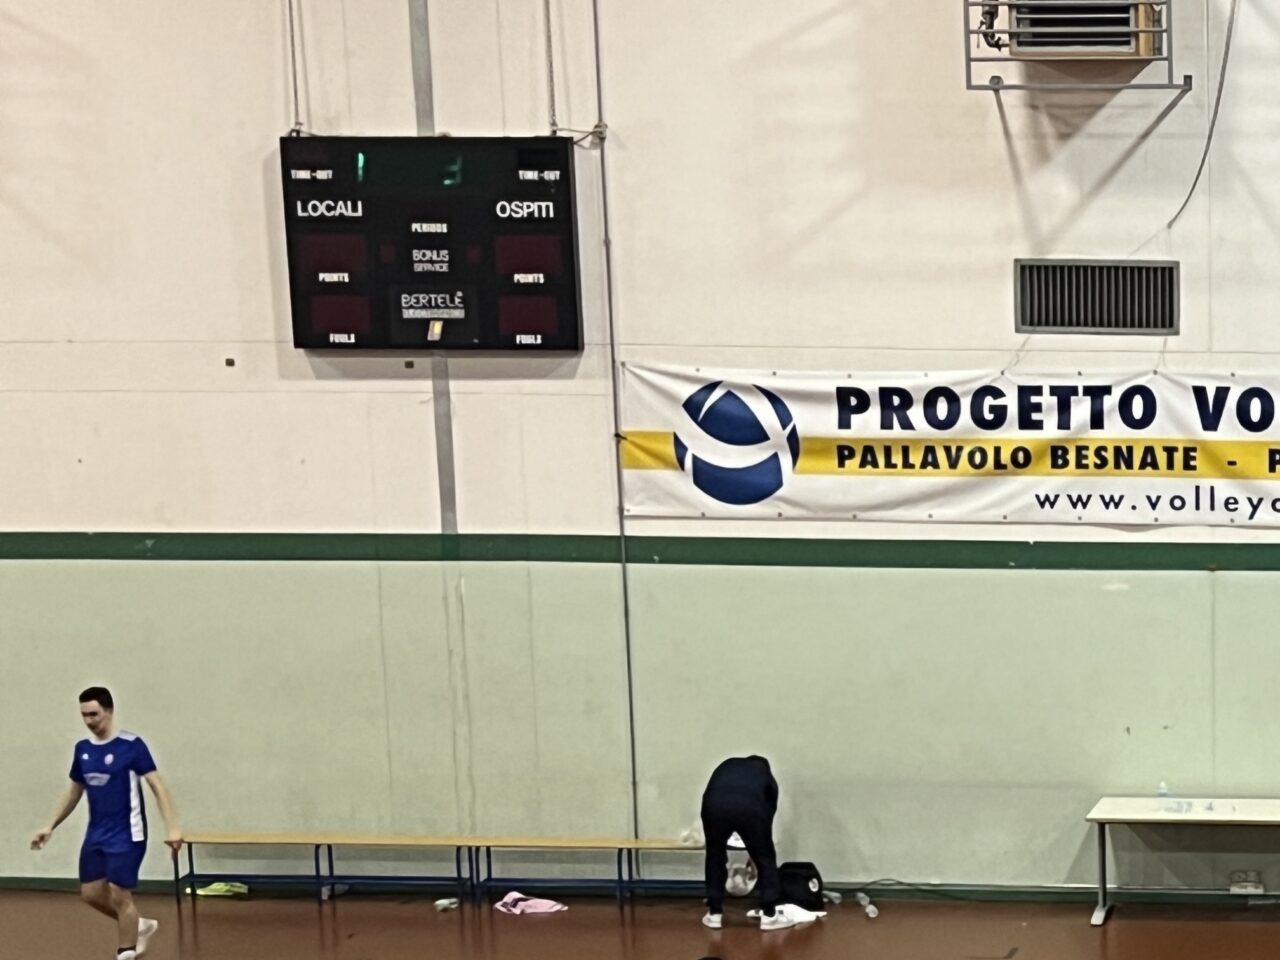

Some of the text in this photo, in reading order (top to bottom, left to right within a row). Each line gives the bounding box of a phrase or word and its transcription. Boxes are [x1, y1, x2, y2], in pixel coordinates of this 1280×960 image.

[296, 199, 363, 217] LOCALI
[495, 200, 554, 218] OSPITI
[412, 249, 449, 261] BONUS
[413, 262, 449, 272] SERVICE
[835, 384, 1158, 432] PROGETTO
[835, 443, 1033, 471] PALLAVOLO
[1049, 444, 1198, 472] BESNATE
